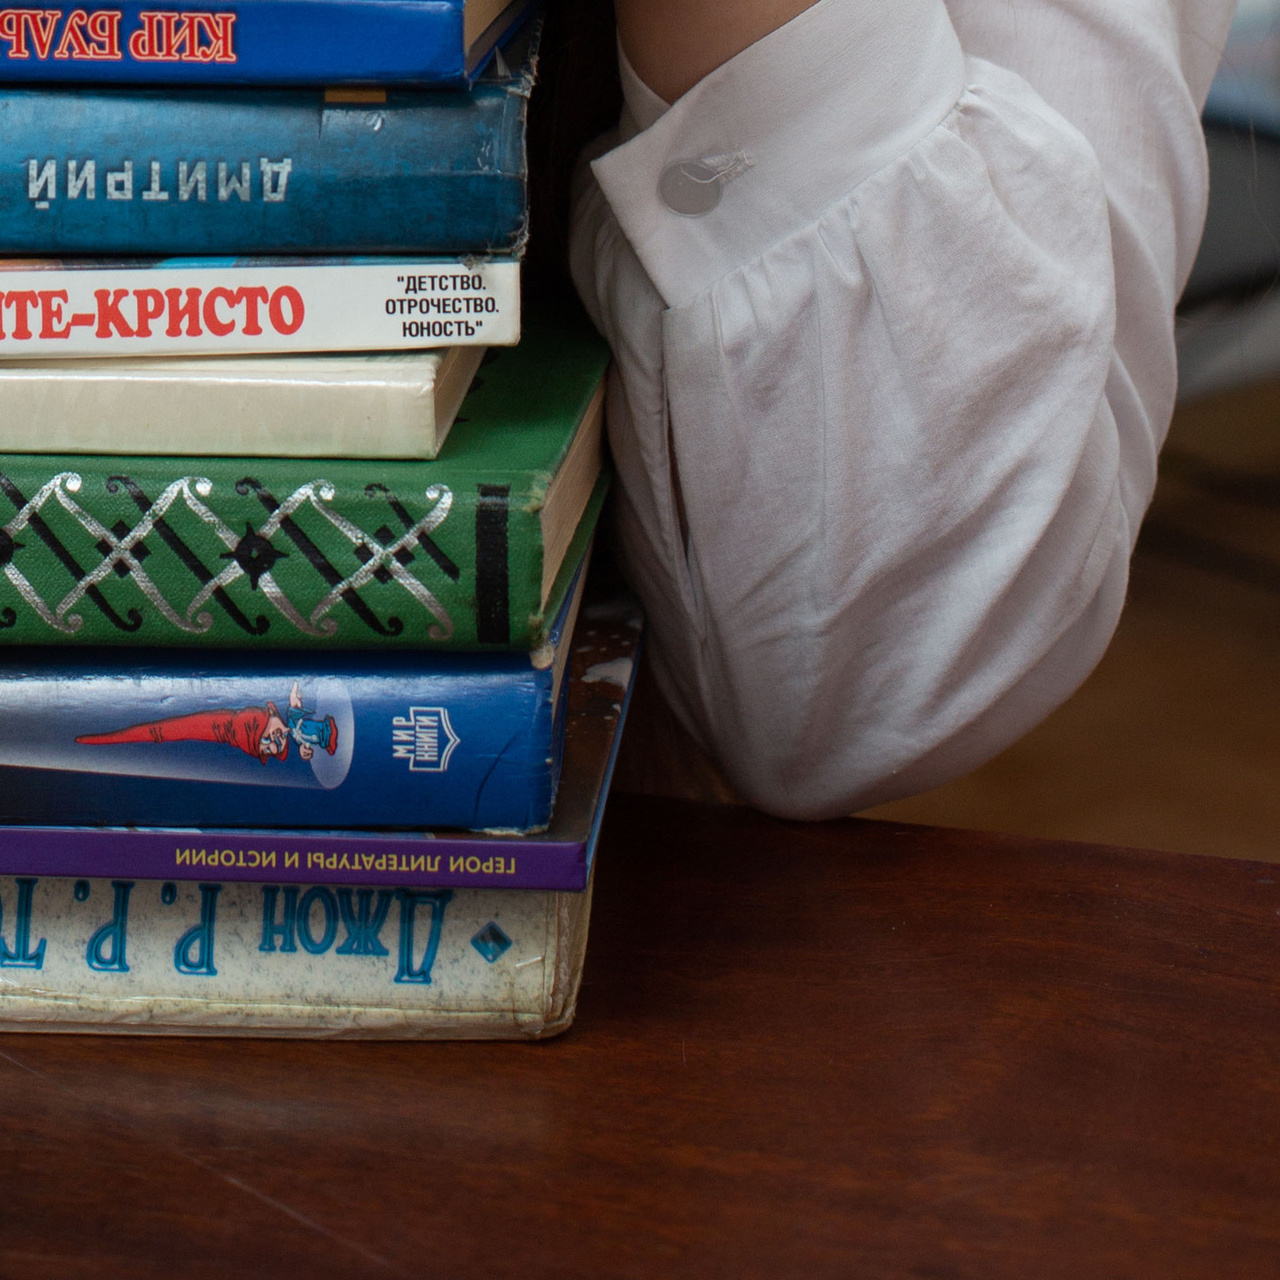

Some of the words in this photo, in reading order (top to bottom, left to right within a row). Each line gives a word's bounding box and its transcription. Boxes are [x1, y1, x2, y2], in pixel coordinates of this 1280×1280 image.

[128, 11, 237, 63] КИР
[26, 157, 293, 210] ДМИТРИЙ
[397, 274, 487, 294] "ДЕТСТВО.
[385, 296, 500, 315] ОТРОЧЕСТВО.
[402, 320, 483, 338] ЮНОСТЬ"
[392, 715, 415, 758] МИР
[415, 715, 439, 761] КНИГИ
[175, 848, 277, 869] ИСТОРИИ
[284, 850, 300, 869] И
[307, 851, 442, 872] ЛИТЕРАТУРЫ
[449, 855, 516, 874] ГЕРОИ
[73, 879, 136, 973] Р.
[160, 881, 223, 976] Р.
[258, 884, 454, 985] Джон
